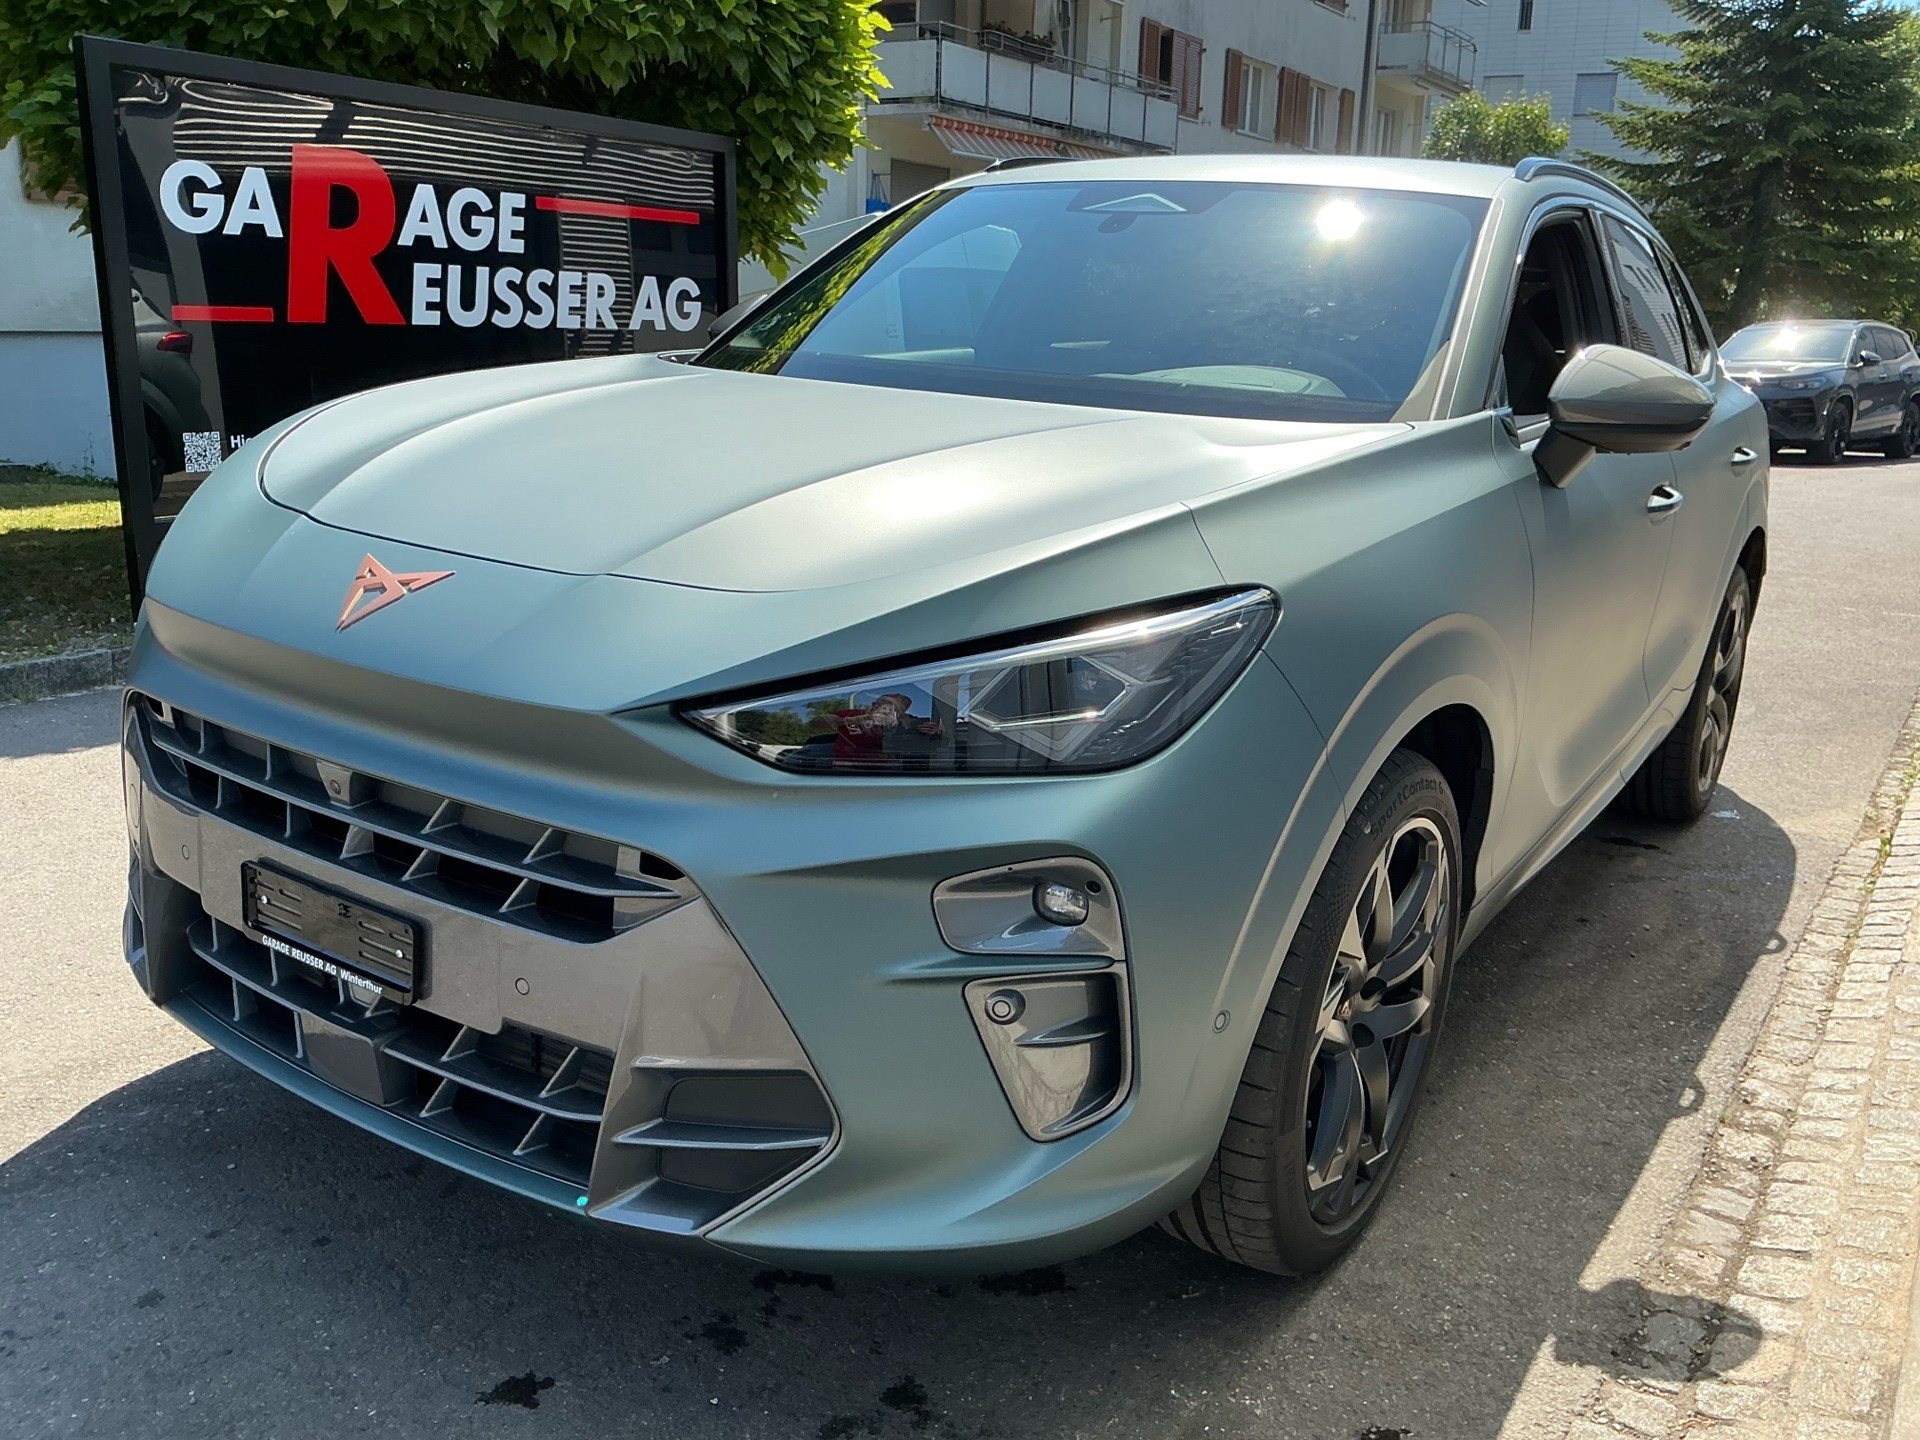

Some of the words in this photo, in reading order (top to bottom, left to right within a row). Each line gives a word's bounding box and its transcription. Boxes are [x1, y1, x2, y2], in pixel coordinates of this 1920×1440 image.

[160, 143, 526, 324] GARAGE
[629, 276, 702, 332] AG
[262, 934, 290, 956] GARAGE
[291, 948, 324, 971] REUSSER
[324, 962, 337, 976] AG
[340, 968, 383, 995] Winterthur
